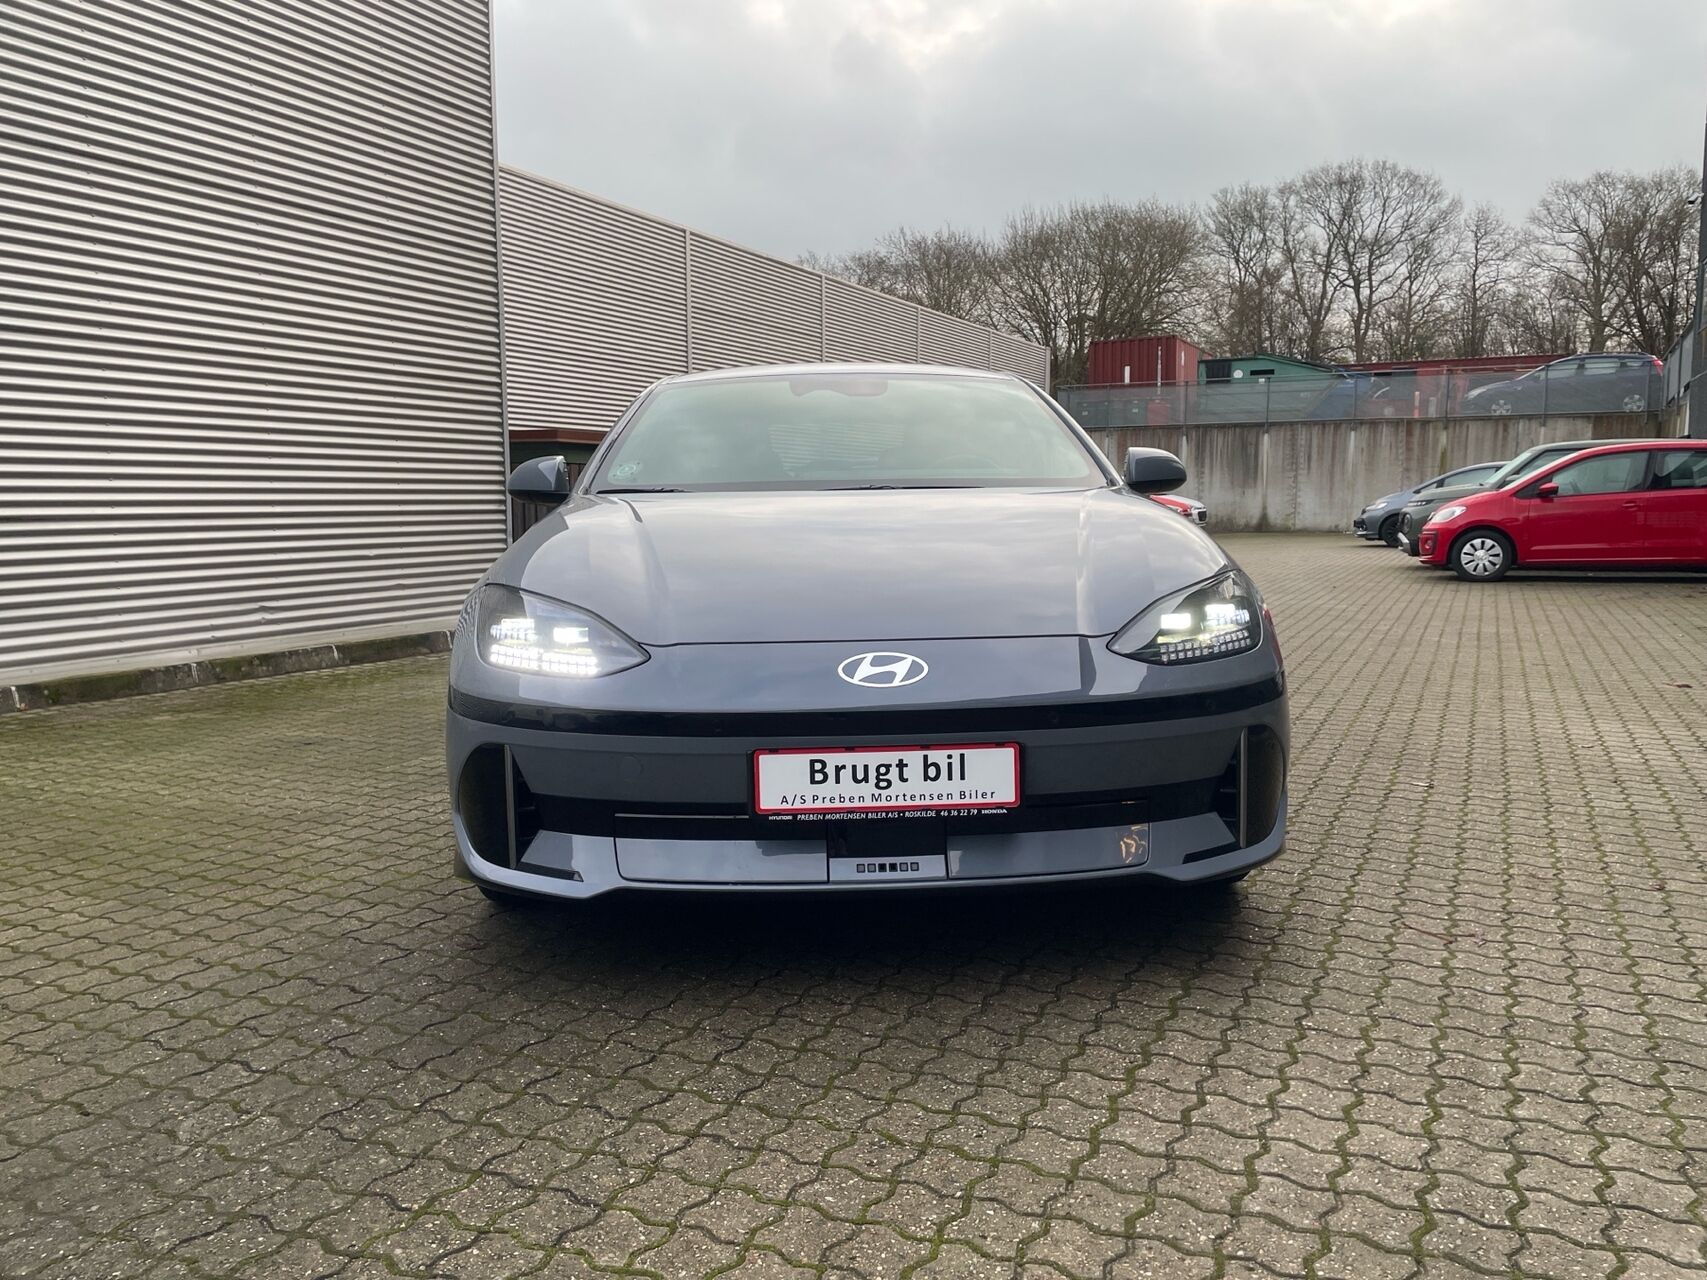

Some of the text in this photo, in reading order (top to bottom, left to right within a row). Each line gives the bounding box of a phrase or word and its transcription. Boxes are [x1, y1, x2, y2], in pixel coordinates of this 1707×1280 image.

[809, 753, 966, 790] Brugt bil
[781, 789, 996, 806] A/S Preben Mortensen Biler
[825, 812, 865, 820] MORTENSEN
[905, 810, 937, 818] ROSKILDE
